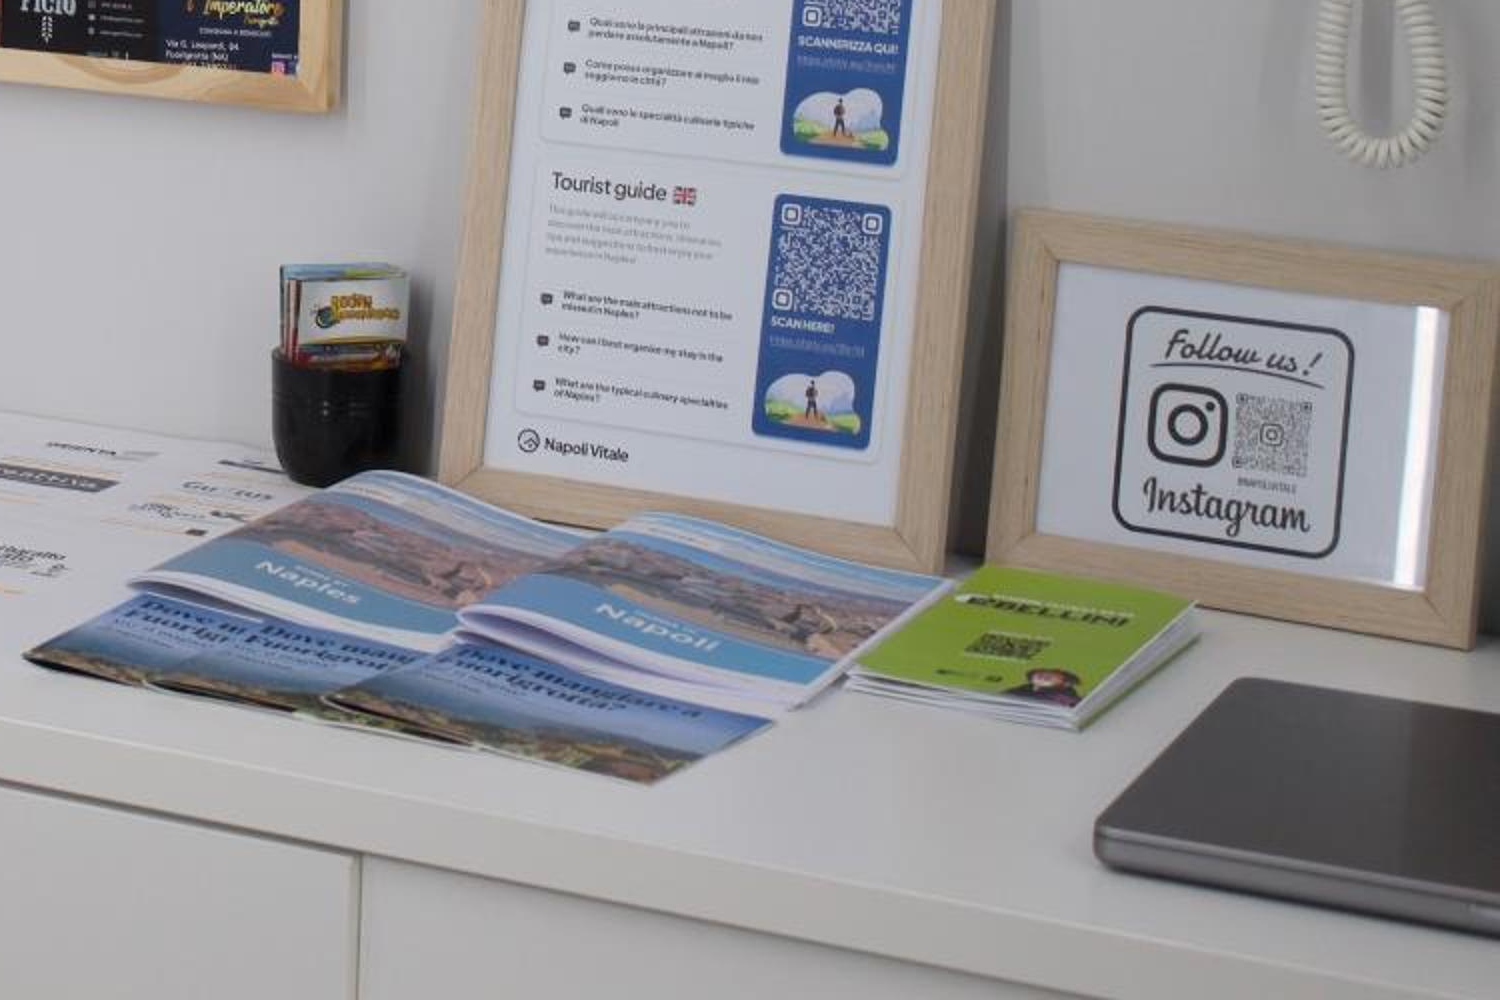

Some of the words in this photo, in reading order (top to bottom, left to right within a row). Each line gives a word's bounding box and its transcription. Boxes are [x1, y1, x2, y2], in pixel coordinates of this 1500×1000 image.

[799, 35, 873, 54] SCANNERIZZA
[552, 171, 611, 196] Tourist
[614, 178, 668, 202] guide
[770, 315, 802, 329] SCAN
[803, 319, 836, 334] HERE!
[1165, 328, 1262, 365] Follow
[543, 435, 590, 458] Napoli
[590, 443, 629, 464] Vitale
[1142, 476, 1311, 538] Instagram
[254, 559, 361, 605] Naples
[595, 602, 721, 653] Napoli
